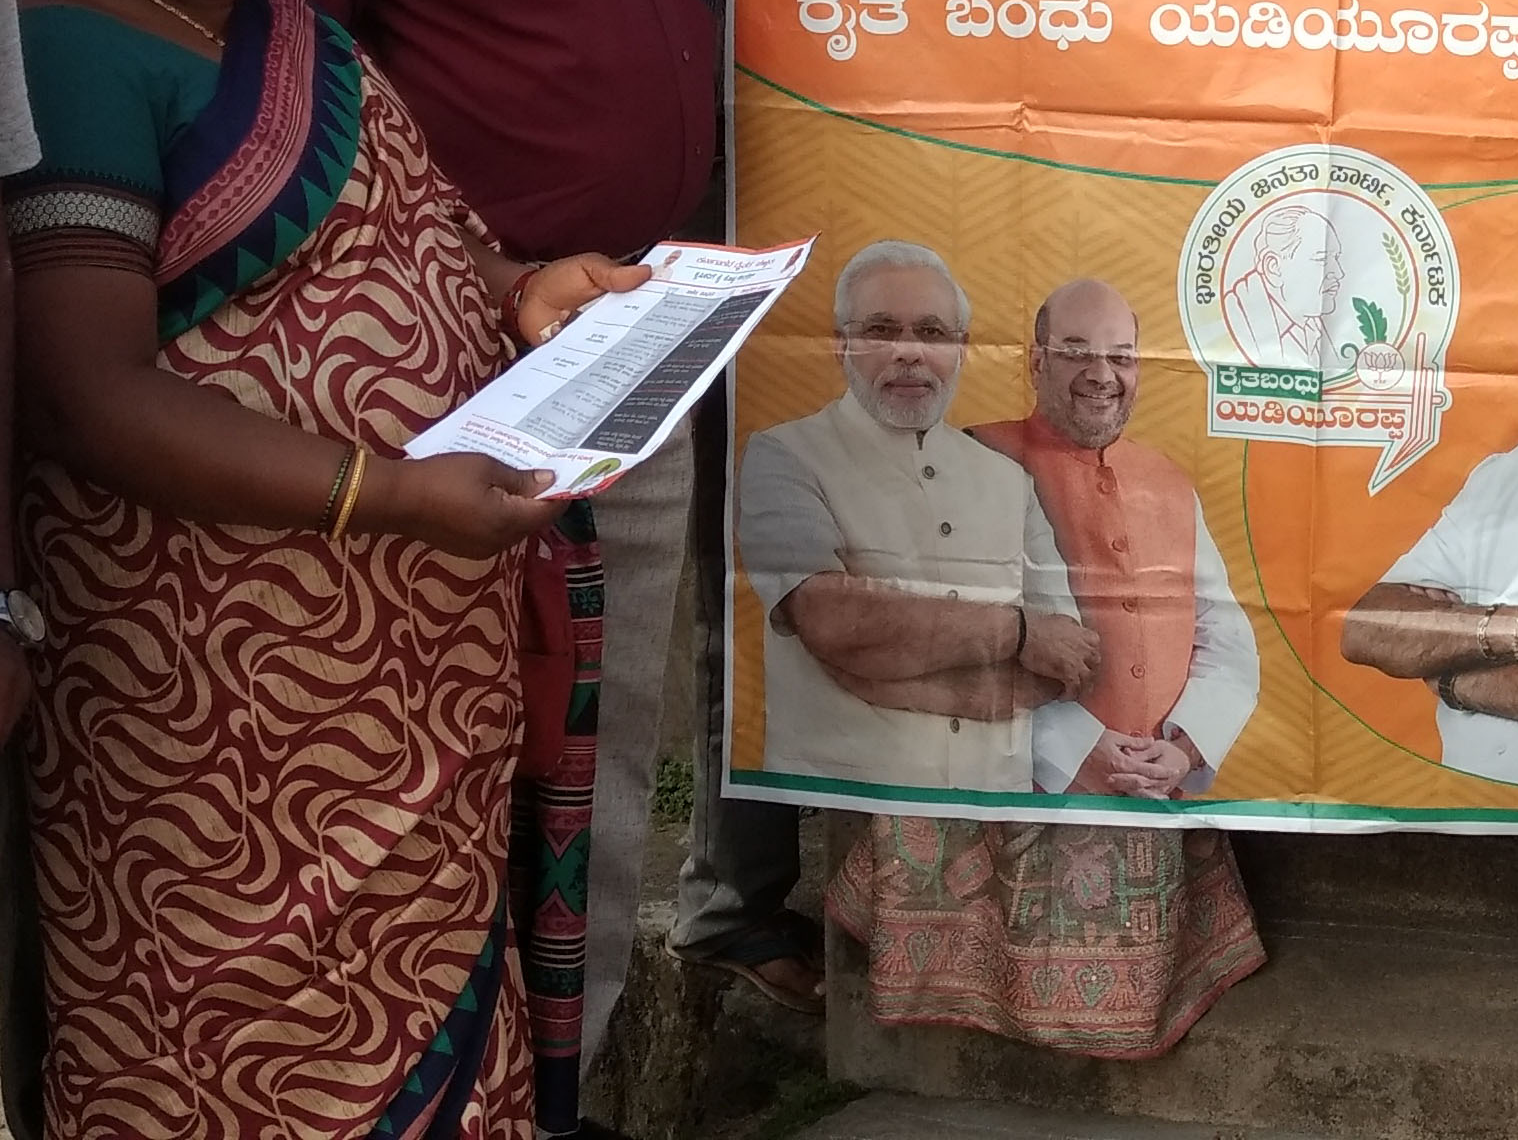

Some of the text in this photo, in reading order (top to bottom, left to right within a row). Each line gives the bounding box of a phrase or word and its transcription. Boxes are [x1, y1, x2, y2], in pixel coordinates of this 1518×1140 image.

[1195, 197, 1247, 305] ಭಾರತೀಯ
[1250, 163, 1320, 199] ಜನತಾ
[1218, 366, 1320, 396] ರೈತಬಂಧು
[1215, 400, 1406, 440] ಯಡಿಯೂರಪ್ಪ
